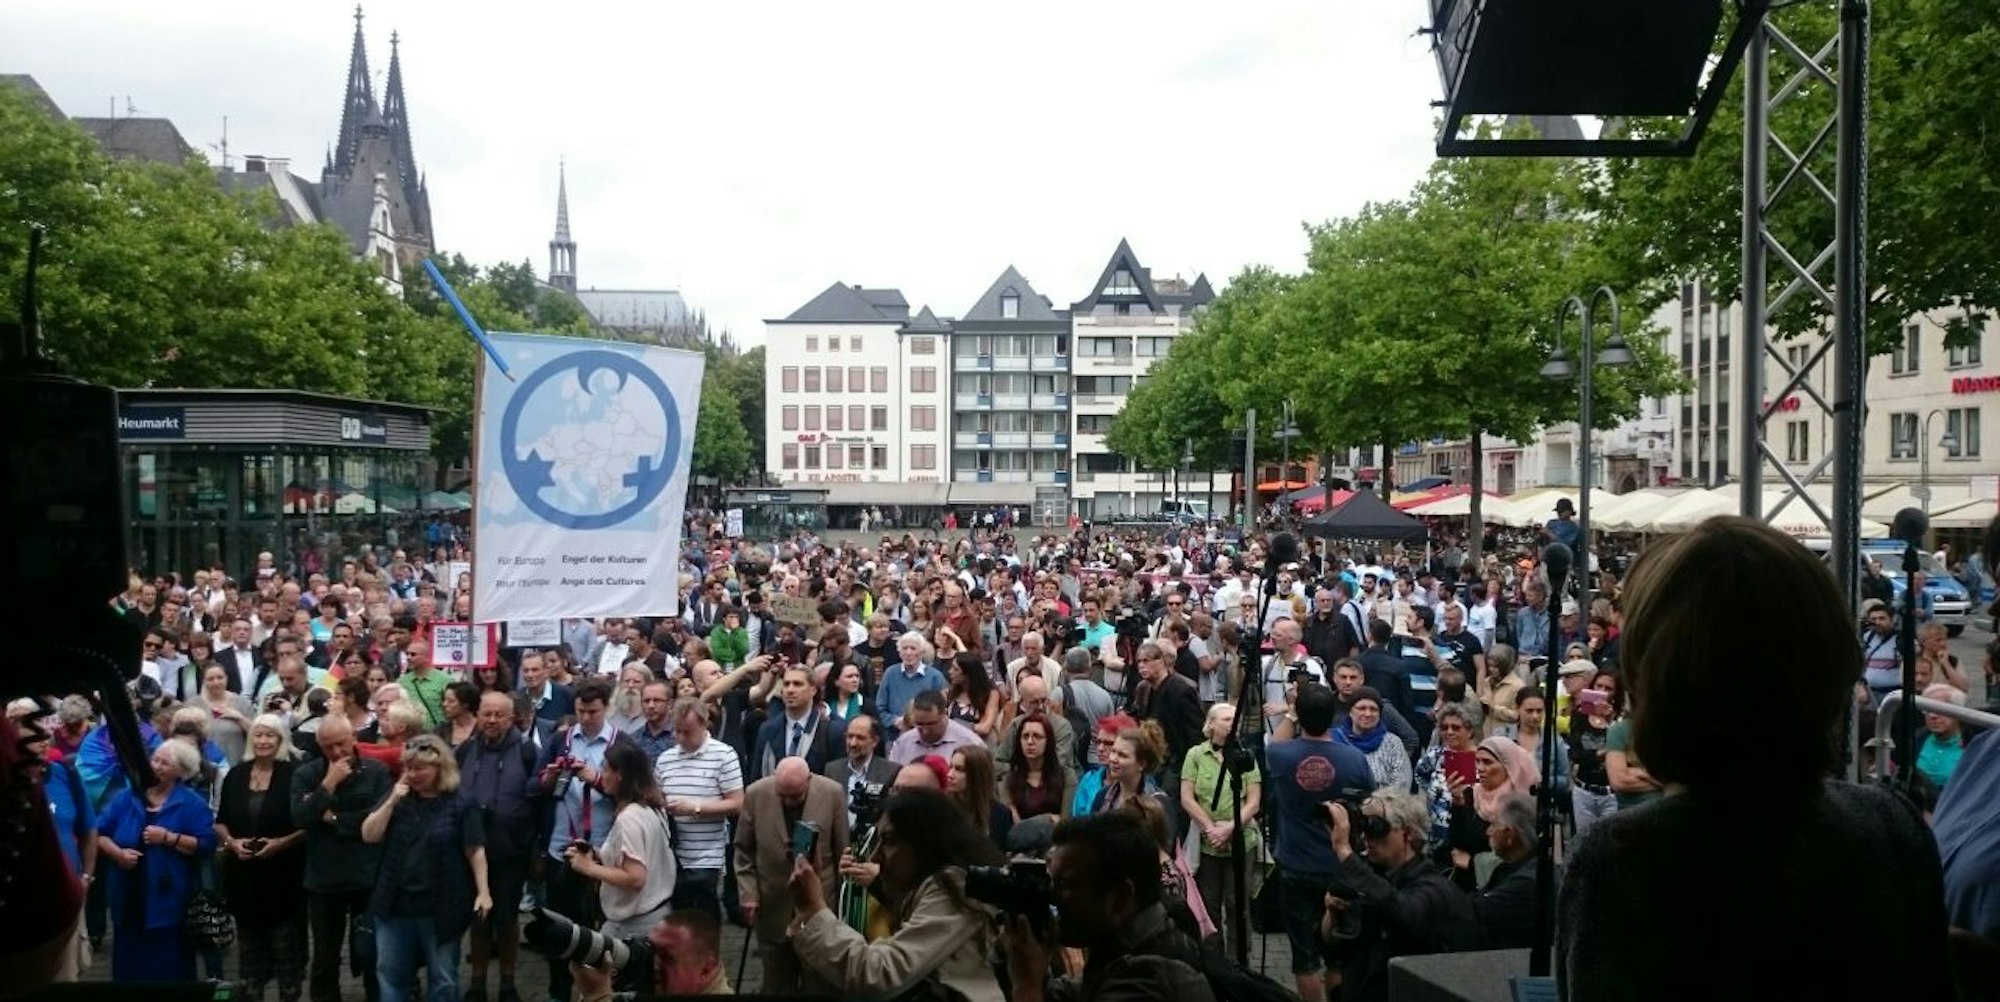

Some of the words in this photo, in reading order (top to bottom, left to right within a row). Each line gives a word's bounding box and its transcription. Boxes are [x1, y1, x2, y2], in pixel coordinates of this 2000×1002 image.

[118, 417, 179, 429] Heumarkt
[562, 554, 588, 566] Engel
[590, 555, 606, 564] der
[608, 555, 648, 564] Kulturen
[560, 577, 585, 588] Ange
[587, 578, 604, 586] des
[606, 577, 646, 586] Cultures
